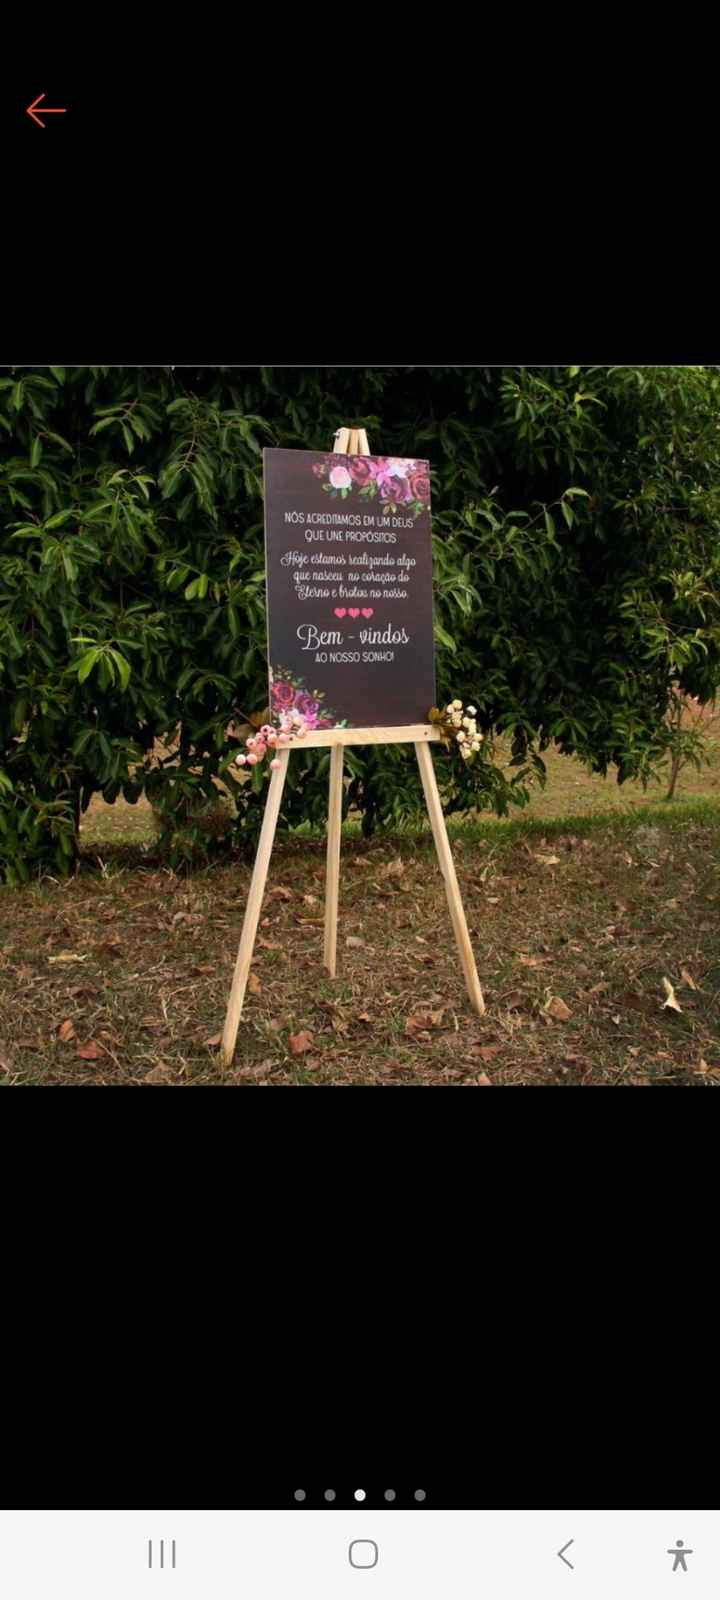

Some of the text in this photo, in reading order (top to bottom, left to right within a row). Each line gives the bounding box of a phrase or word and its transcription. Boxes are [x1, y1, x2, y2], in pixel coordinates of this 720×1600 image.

[284, 511, 414, 528] NÓS ACREDITAMOS EM UM DEUS
[304, 530, 397, 543] QUE UNE PROPÓSITOS
[280, 551, 416, 570] Hoje estamos realizando algo
[293, 572, 312, 584] que
[348, 573, 360, 581] no
[362, 573, 397, 584] coração
[398, 570, 410, 582] do
[295, 584, 330, 600] Eterno
[332, 589, 338, 598] e
[370, 589, 381, 598] no
[296, 624, 344, 650] Bem
[360, 623, 410, 644] vindos
[315, 652, 394, 662] AO NOSSO SONHO!
